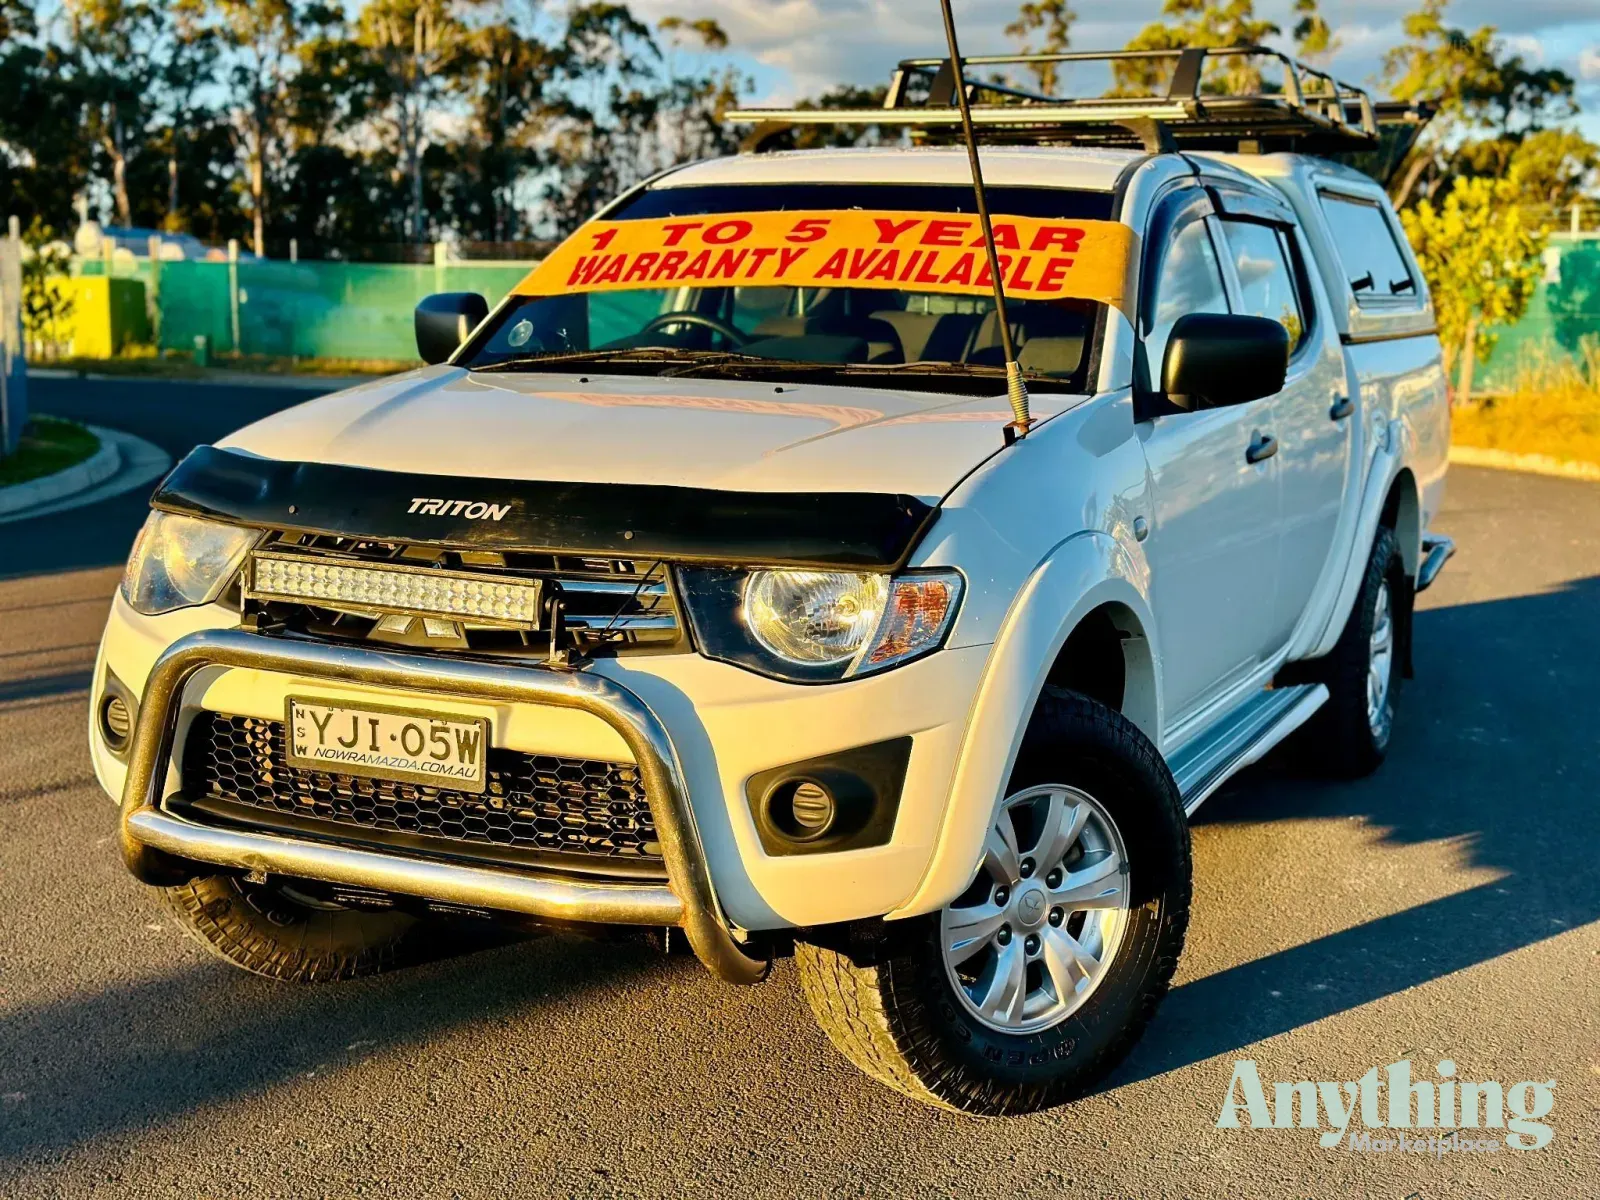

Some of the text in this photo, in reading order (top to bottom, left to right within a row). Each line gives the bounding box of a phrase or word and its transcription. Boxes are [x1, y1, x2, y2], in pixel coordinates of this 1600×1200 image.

[592, 218, 1086, 253] 1 TO 5 YEAR
[566, 247, 1075, 292] WARRANTY AVAILABLE
[407, 497, 512, 521] TRITON
[313, 747, 476, 778] NOWRAMAZDA.COM.AU
